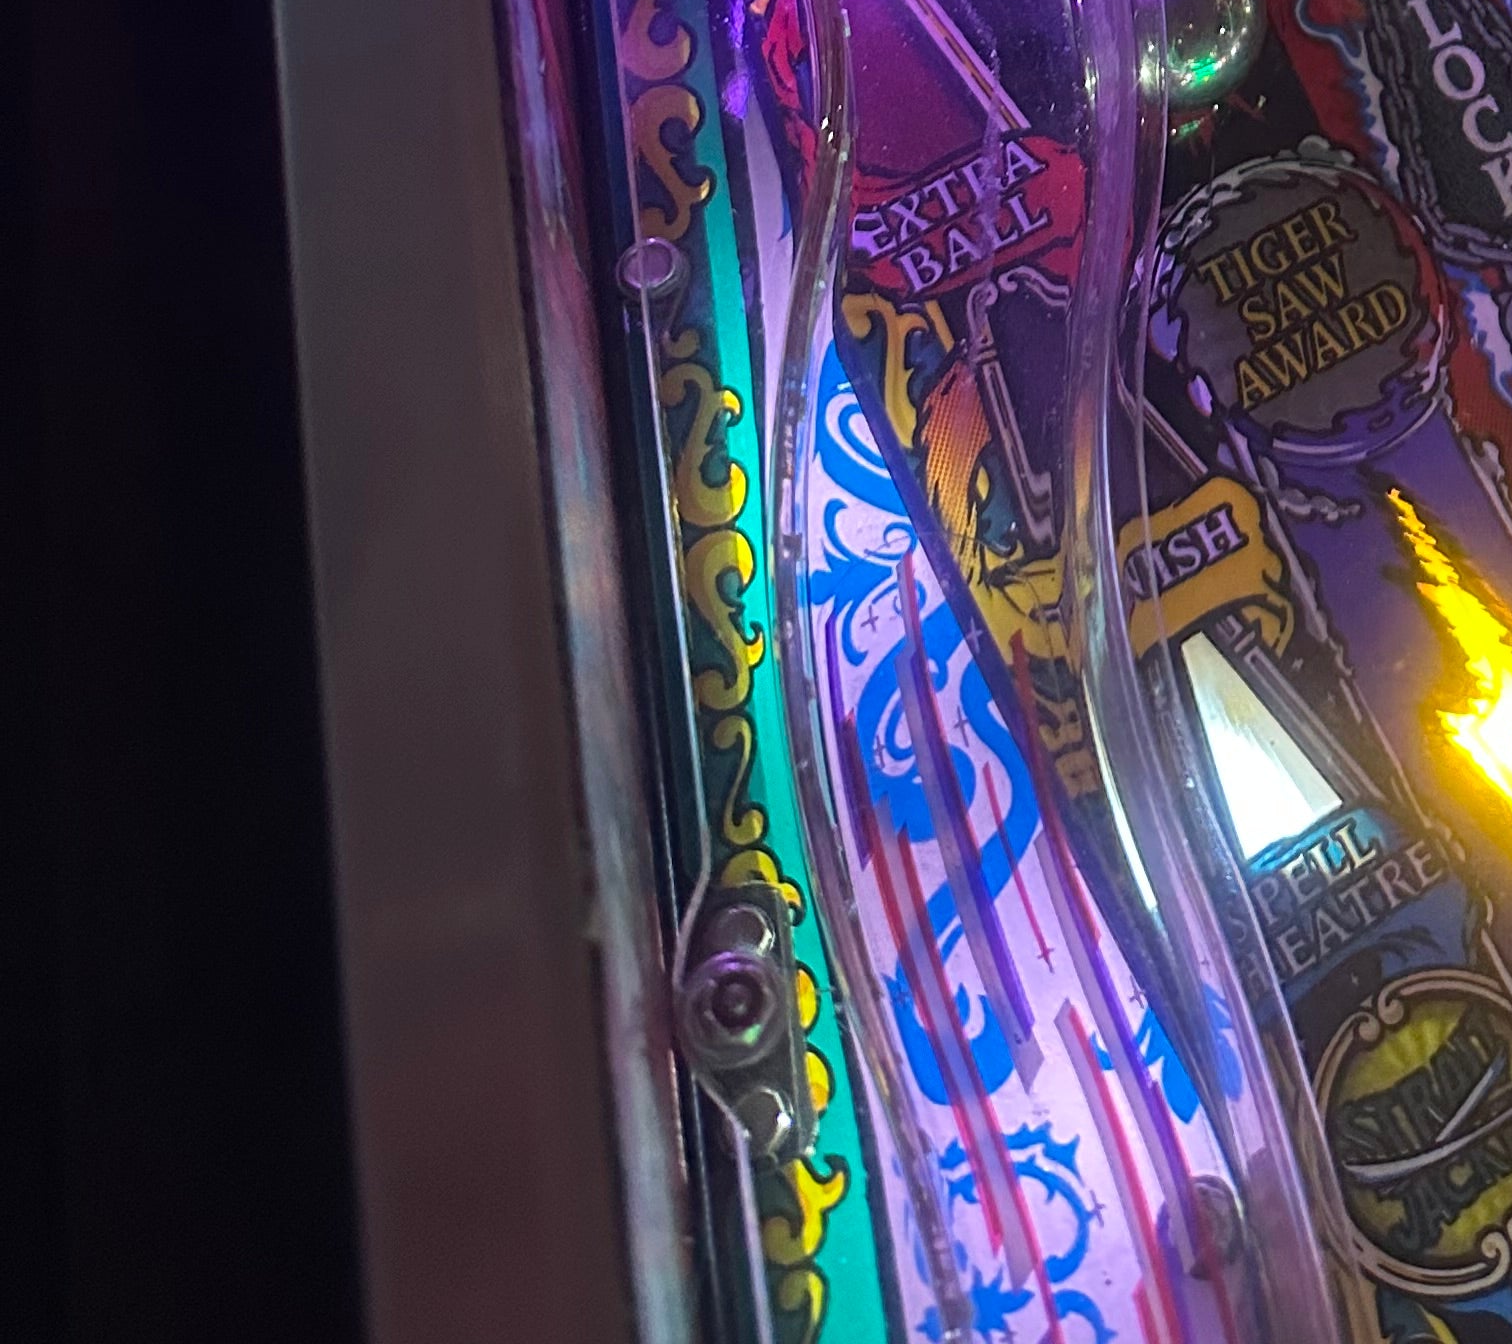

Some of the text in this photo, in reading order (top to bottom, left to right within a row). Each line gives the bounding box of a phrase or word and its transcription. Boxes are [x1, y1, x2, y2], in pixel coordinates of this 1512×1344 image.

[853, 139, 1047, 258] EXTRA
[899, 193, 1049, 293] BALL
[1201, 202, 1356, 307] TIGER
[1241, 261, 1350, 345] SAW
[1235, 283, 1408, 412] AWARD
